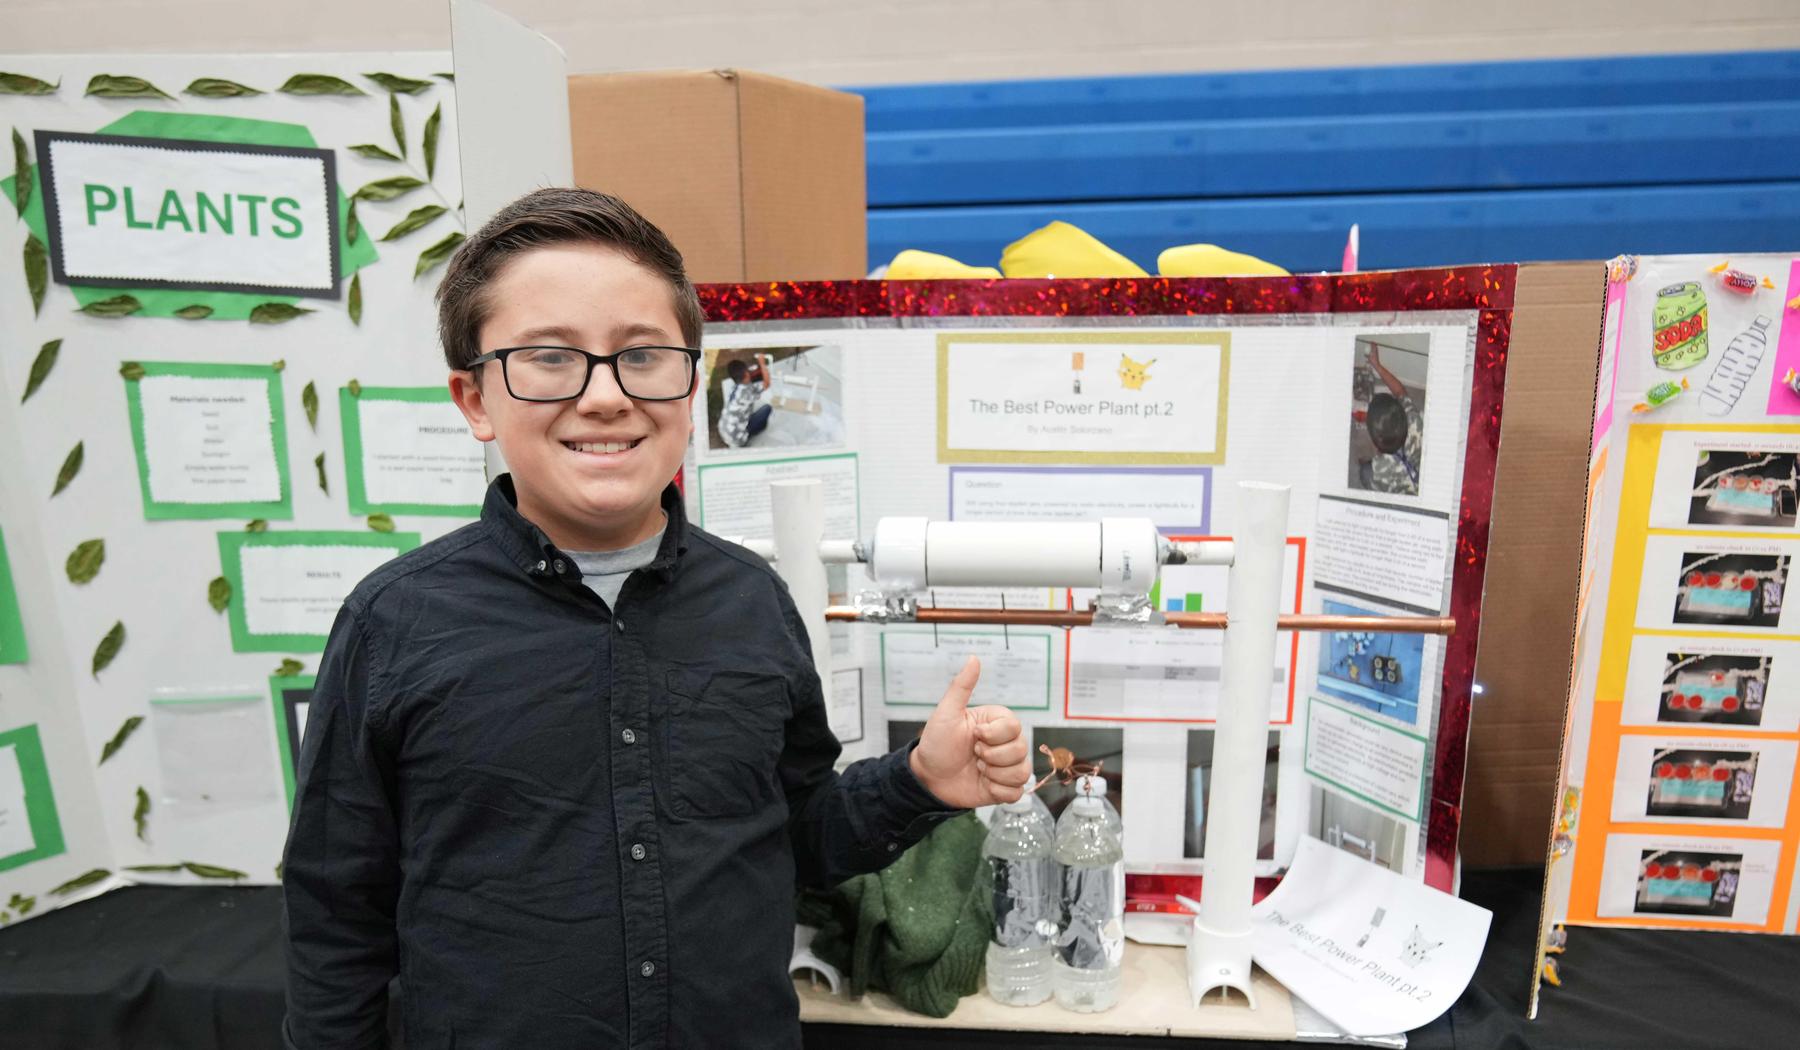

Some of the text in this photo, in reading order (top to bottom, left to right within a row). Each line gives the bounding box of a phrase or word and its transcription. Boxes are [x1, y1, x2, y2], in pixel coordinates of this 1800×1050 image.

[84, 183, 304, 240] PLANTS
[1655, 314, 1703, 351] SODA
[969, 399, 1174, 419] The Best Power Plant pt.2
[1266, 910, 1290, 927] The
[1289, 922, 1321, 945] Best
[1320, 938, 1363, 967] Power
[1361, 960, 1402, 987] Plant
[1397, 980, 1433, 1003] pt.2
